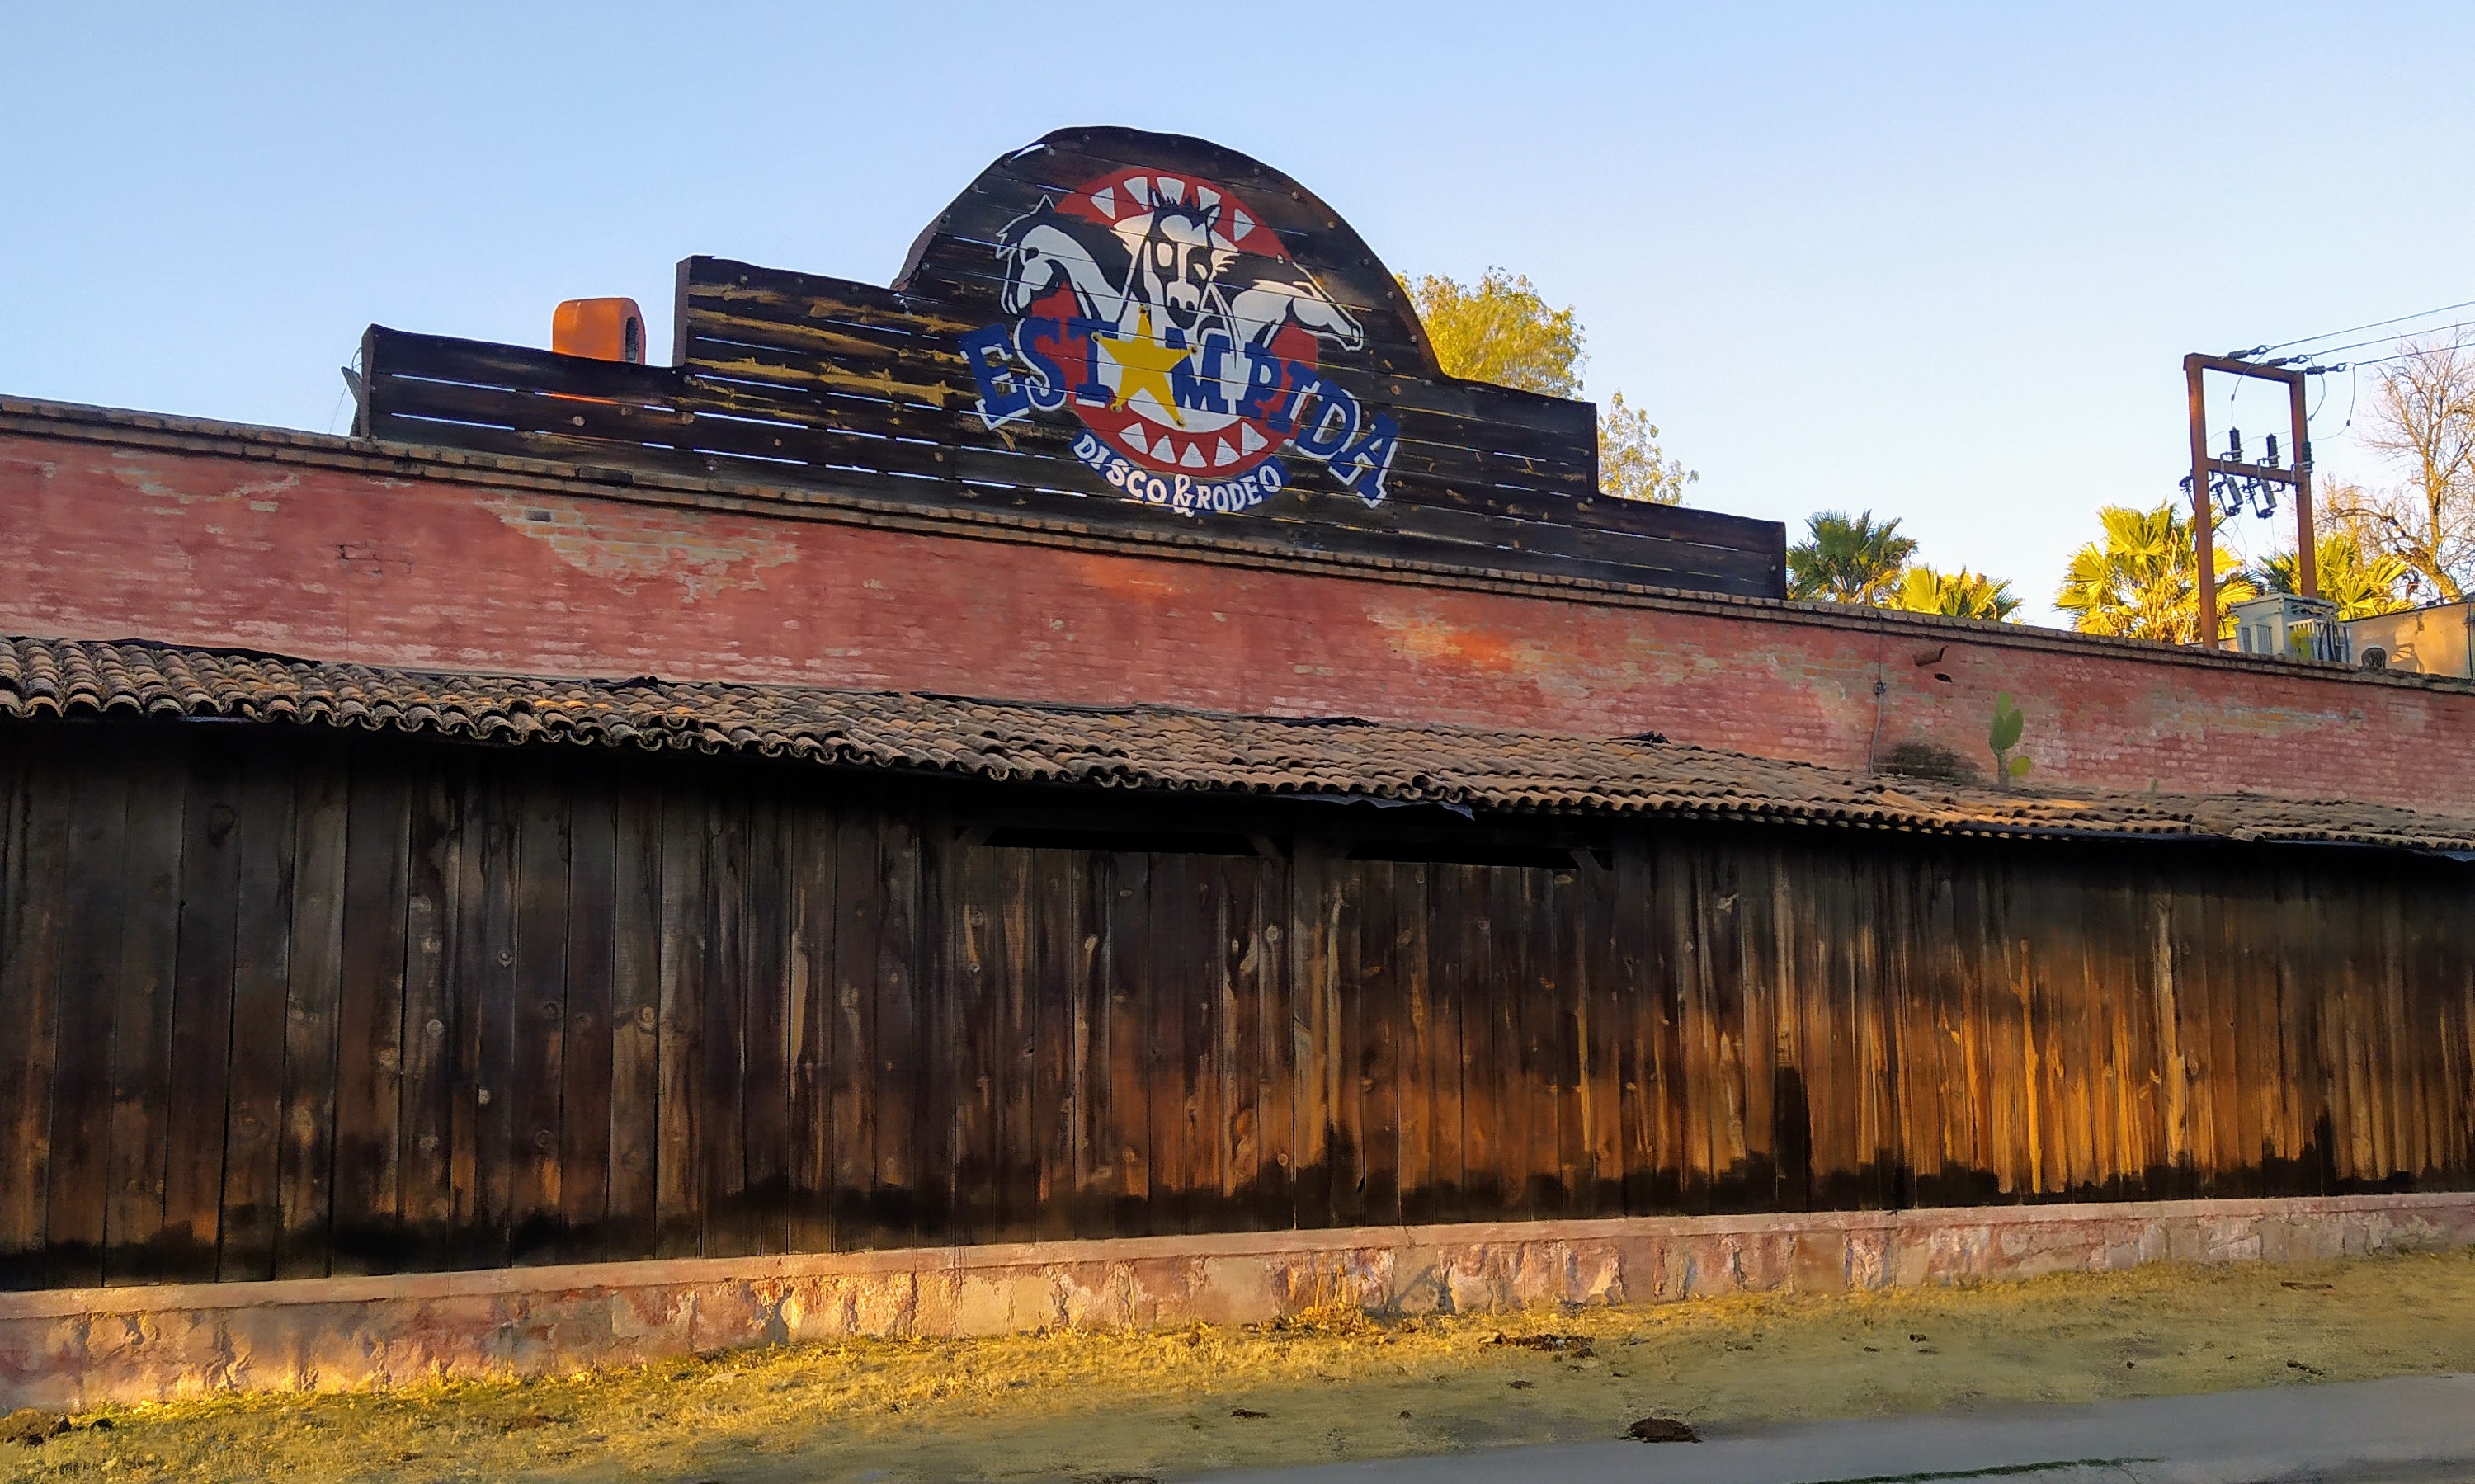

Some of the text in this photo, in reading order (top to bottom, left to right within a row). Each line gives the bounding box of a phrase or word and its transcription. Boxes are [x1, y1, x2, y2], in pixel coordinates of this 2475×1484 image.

[958, 318, 1399, 508] ESTMPIDA
[1072, 433, 1282, 518] DISCO & RODEO
